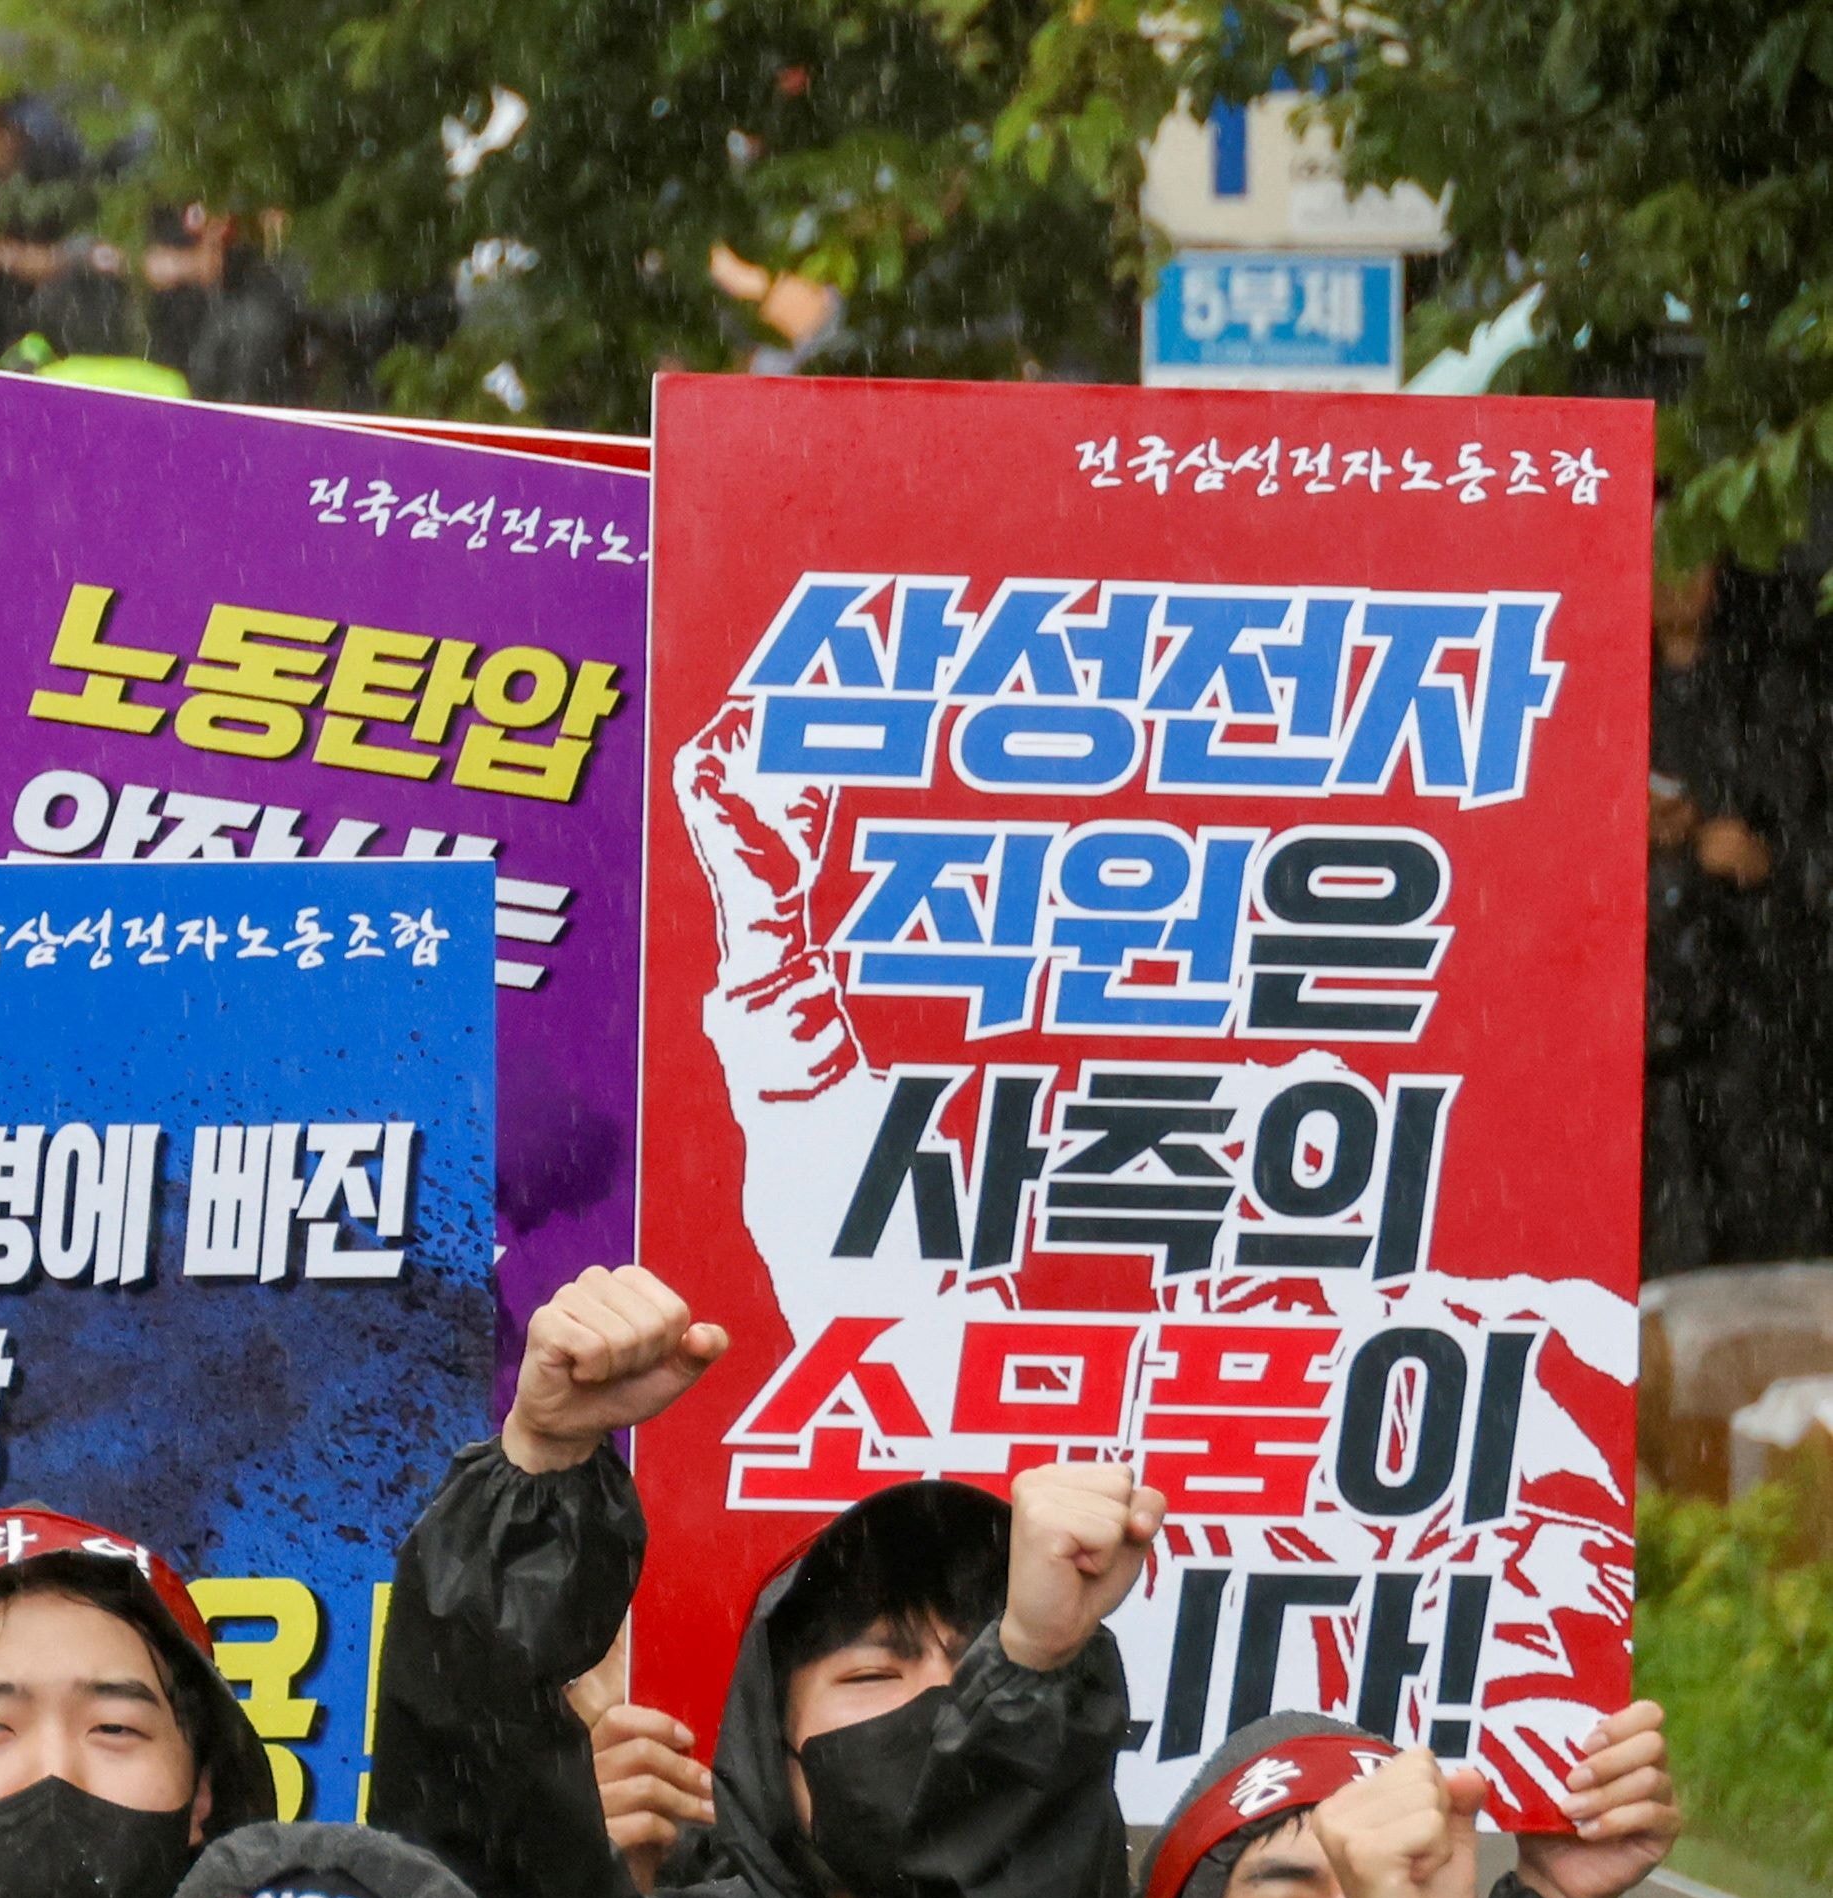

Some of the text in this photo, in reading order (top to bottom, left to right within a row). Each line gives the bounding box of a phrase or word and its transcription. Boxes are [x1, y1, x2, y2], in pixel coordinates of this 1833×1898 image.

[308, 475, 650, 562] 전국삼성전자노
[1075, 435, 1610, 506] 전국삼성전자노동조합
[28, 582, 621, 801] 노동탄압
[727, 571, 1567, 810] 삼성전자
[826, 817, 1456, 1044] 직원은
[181, 1120, 414, 1284] 빠진
[830, 1063, 1464, 1282] 사측의
[722, 1310, 1540, 1526] 소모품이
